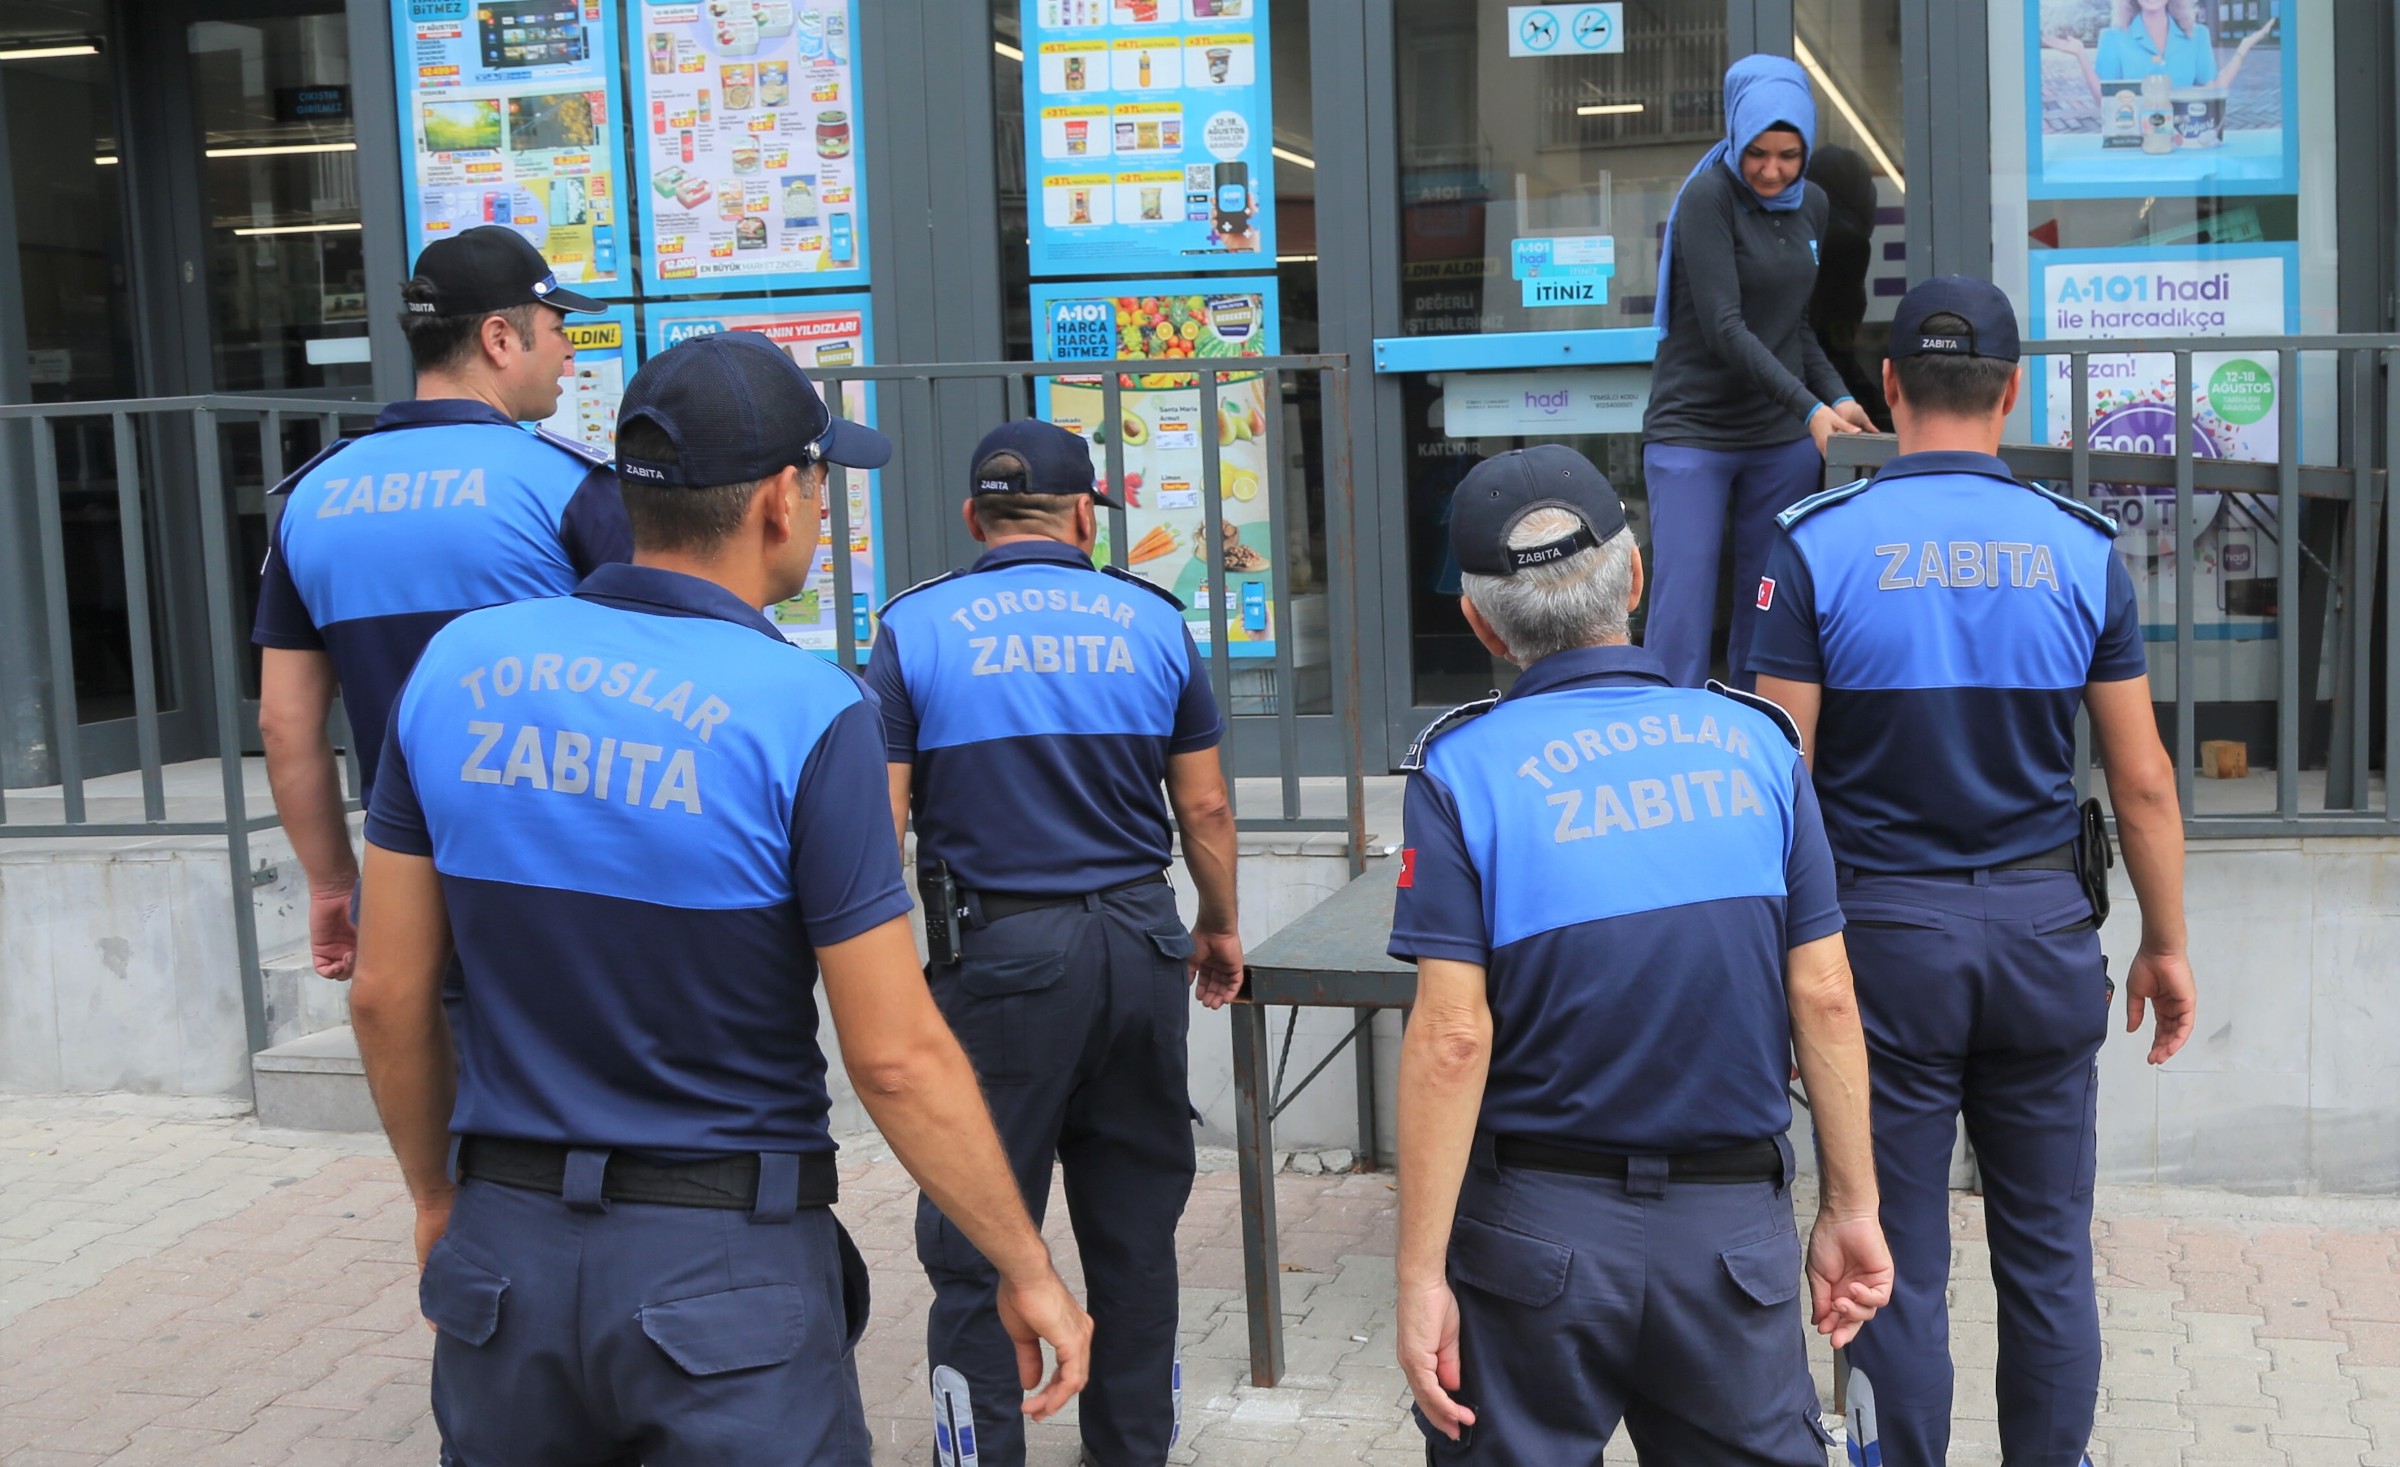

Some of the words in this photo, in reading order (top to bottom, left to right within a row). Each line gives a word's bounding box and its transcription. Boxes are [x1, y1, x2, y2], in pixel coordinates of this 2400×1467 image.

[700, 265, 711, 273] EN
[713, 262, 741, 272] BÜYÜK
[1520, 253, 1547, 264] hadi
[1536, 281, 1594, 301] İTİNİZ
[2156, 273, 2230, 301] hadi
[1415, 292, 1474, 311] DEĞERLİ
[796, 321, 857, 336] YILDIZLARI
[1057, 321, 1108, 334] HARCA
[2057, 309, 2084, 329] ile
[2090, 308, 2225, 332] harcadıkça
[1057, 333, 1109, 347] HARCA
[1922, 338, 1958, 350] ZABITA
[2058, 358, 2136, 378] kzan!
[2225, 371, 2256, 382] 12-18
[2211, 380, 2272, 394] AĞUSTOS
[1525, 390, 1569, 408] hadi
[626, 463, 665, 480] ZABITA
[316, 468, 487, 520] ZABITA
[981, 479, 1009, 491] ZABITA
[1517, 547, 1562, 565] ZABITA
[1875, 540, 2060, 592] ZABITA
[951, 588, 1136, 632] TOROSLAR
[969, 634, 1136, 677] ZABITA
[460, 653, 731, 744] TOROSLAR
[1516, 713, 1750, 790] TOROSLAR
[460, 720, 703, 815] ZABITA
[1545, 769, 1765, 844] ZABITA
